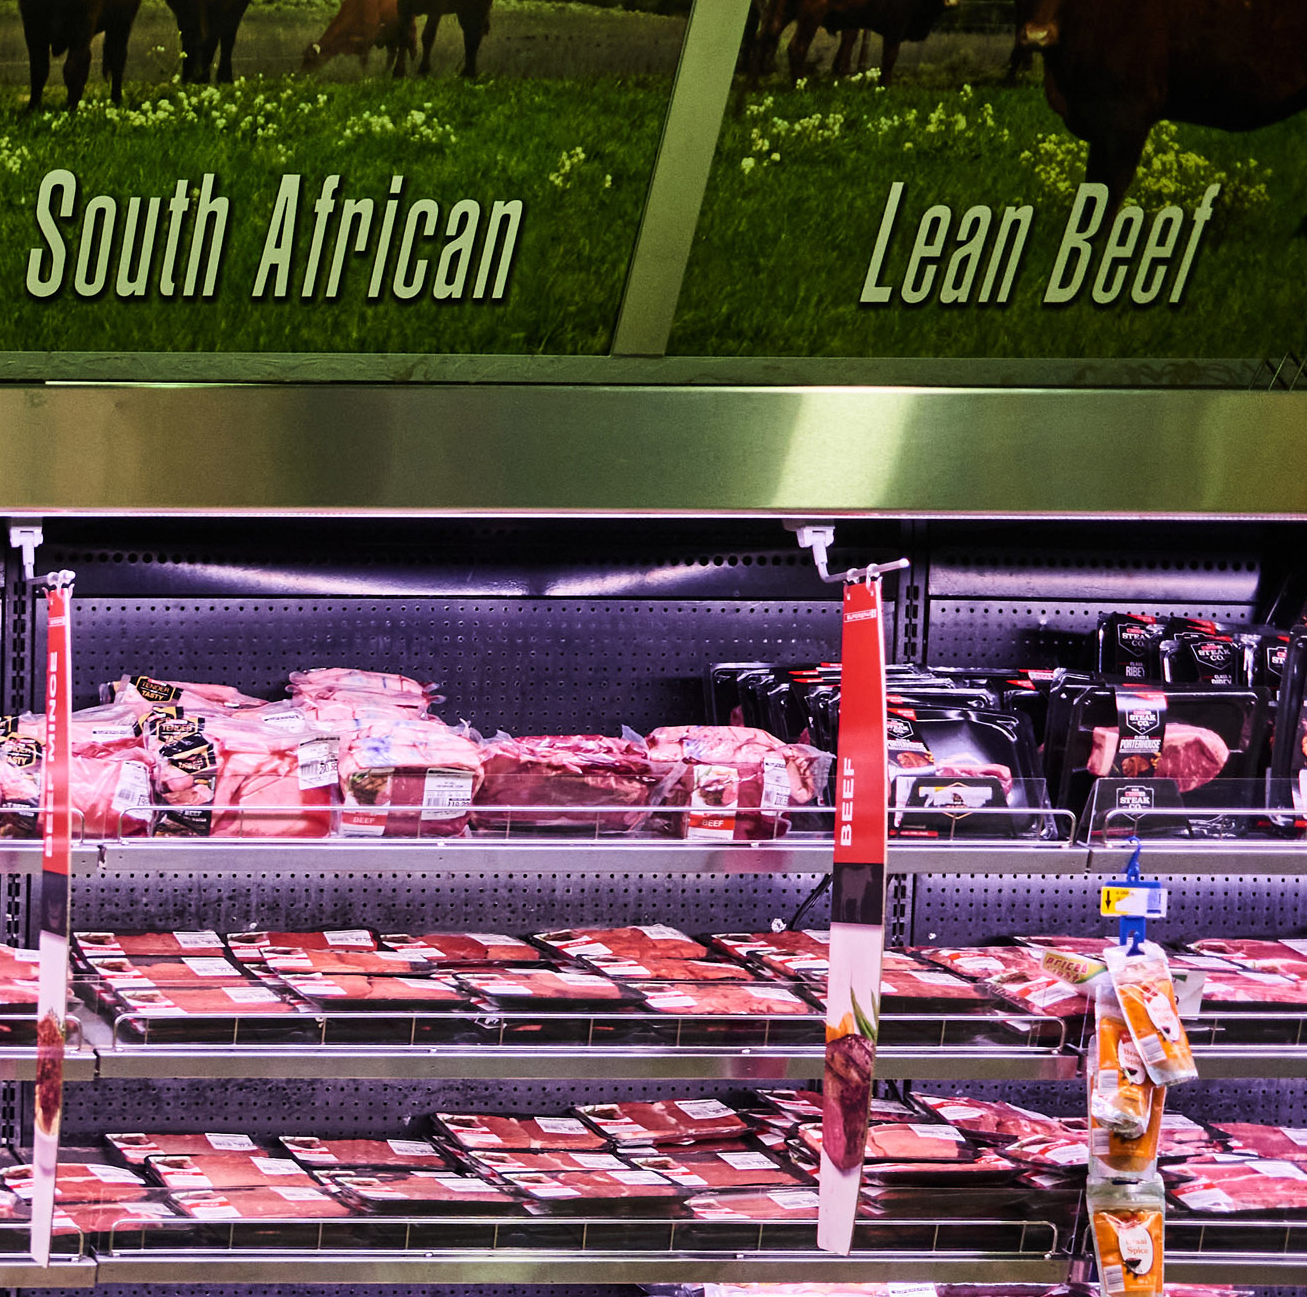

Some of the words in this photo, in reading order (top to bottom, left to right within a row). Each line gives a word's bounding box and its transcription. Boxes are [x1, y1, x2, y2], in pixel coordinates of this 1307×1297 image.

[25, 168, 230, 302] South
[250, 171, 526, 303] African
[857, 180, 1032, 307] Lean
[1040, 181, 1217, 310] Beef
[1198, 648, 1231, 656] STEAK
[141, 681, 170, 694] TENDER
[142, 690, 164, 701] TASTY
[47, 651, 58, 762] MINCE
[1129, 713, 1156, 721] STEAK
[1119, 739, 1162, 750] PORTERHOUSE
[840, 757, 854, 847] BEEF
[1120, 796, 1150, 804] STEAK
[353, 816, 375, 825] BEEF
[701, 818, 724, 828] BEEF
[1127, 1246, 1149, 1256] Spice
